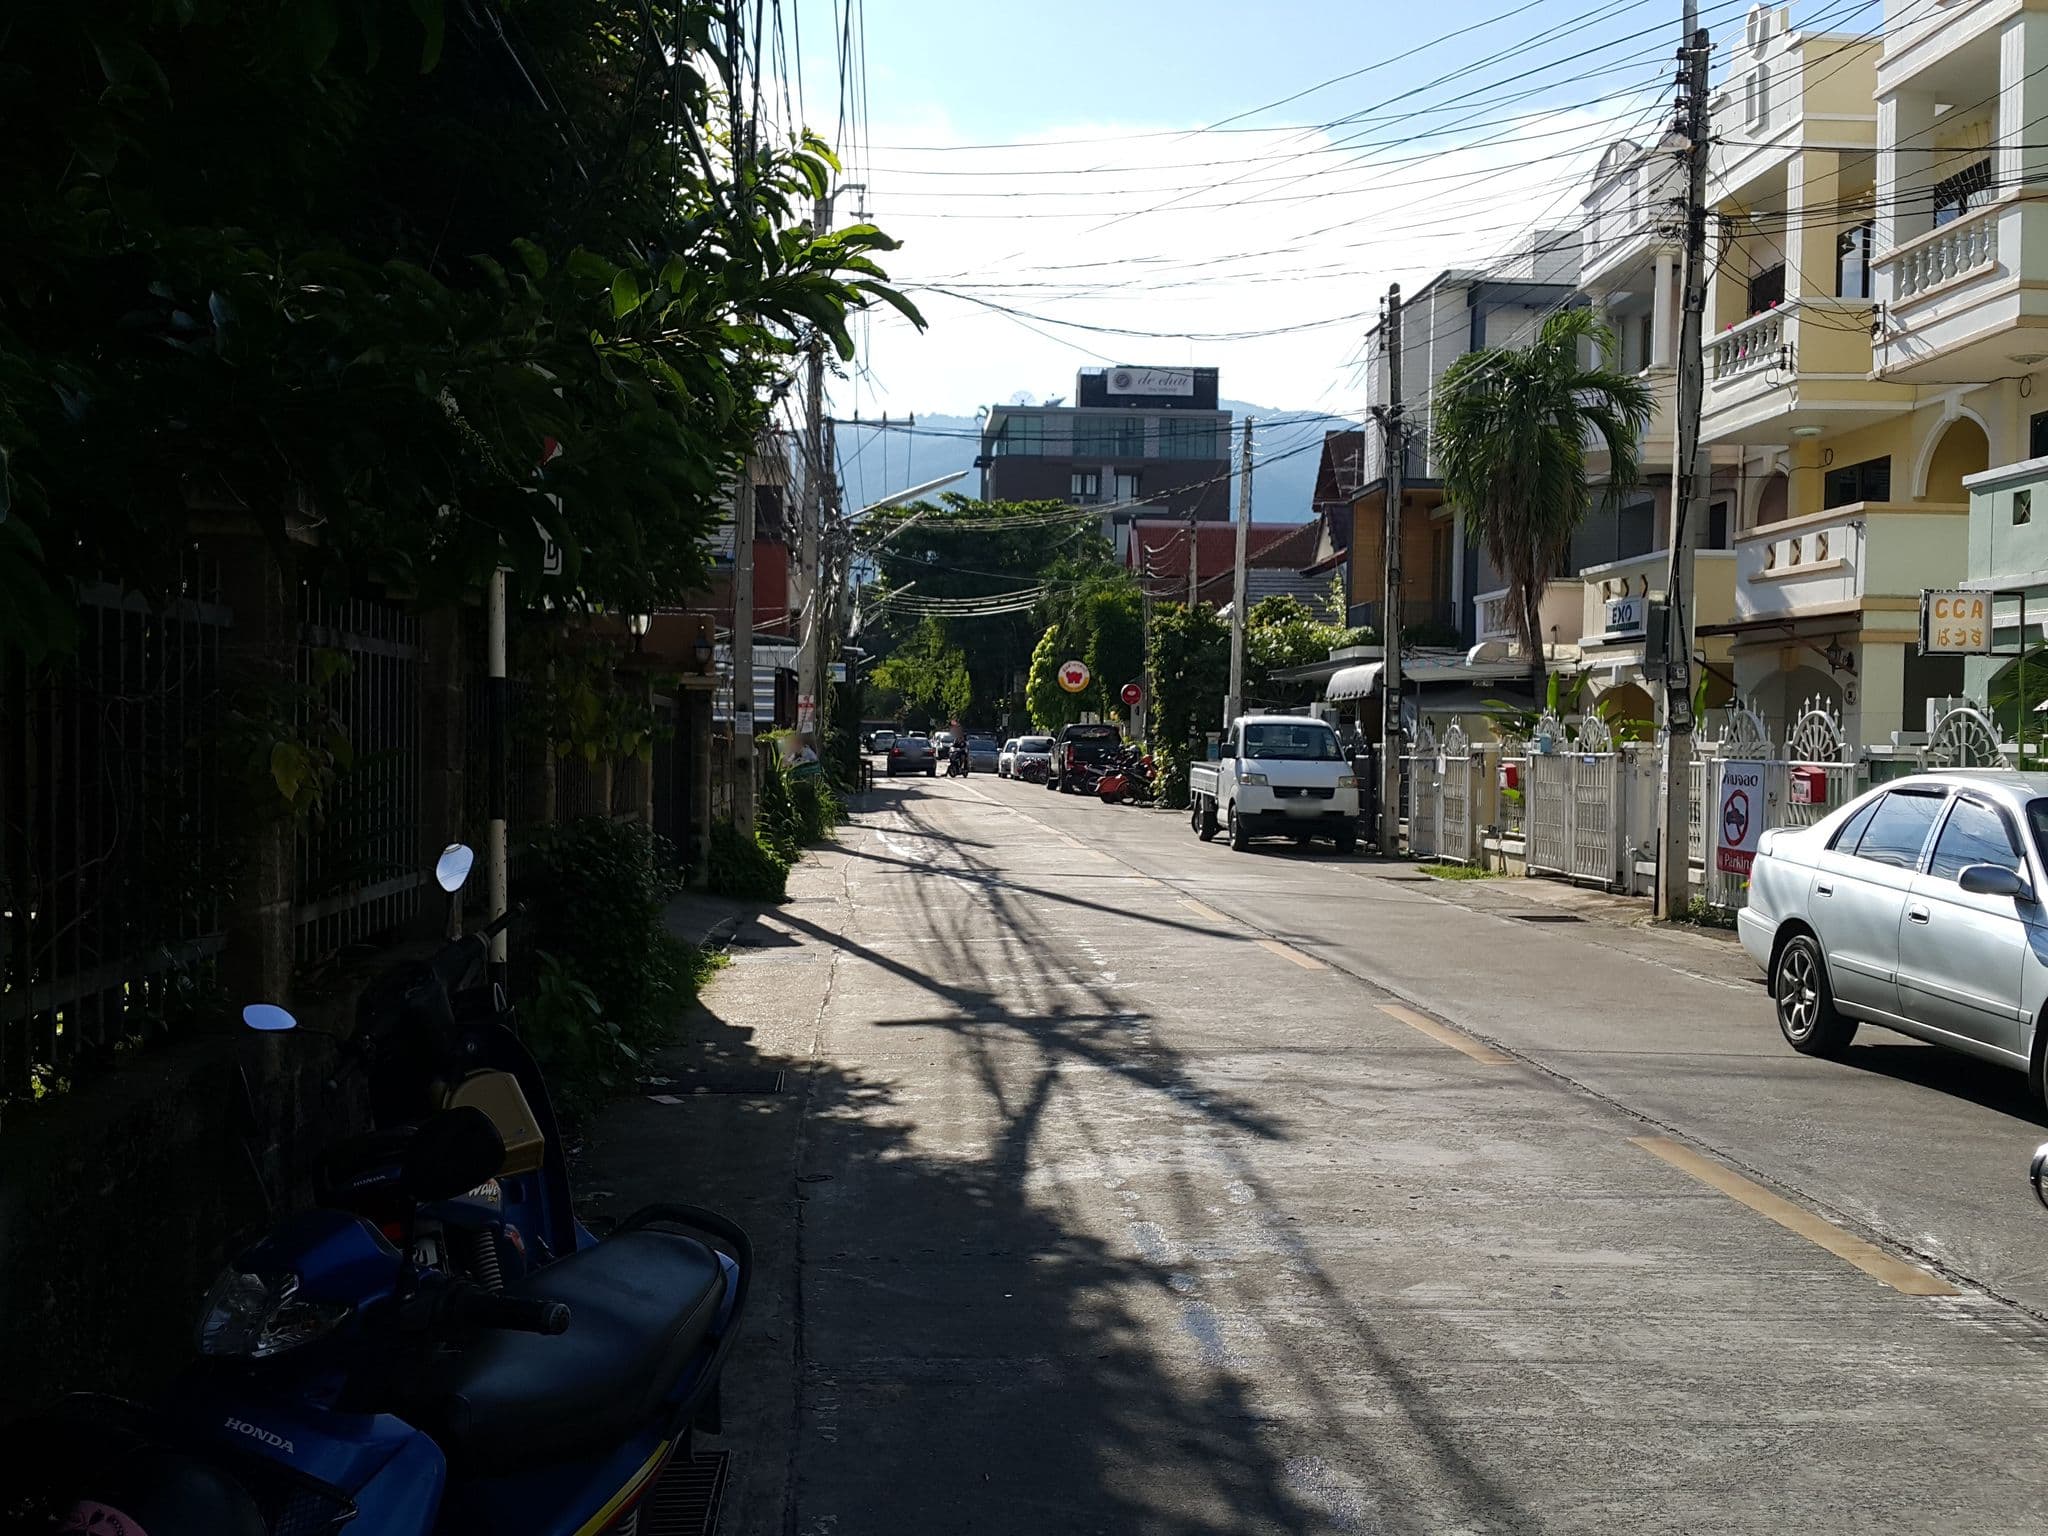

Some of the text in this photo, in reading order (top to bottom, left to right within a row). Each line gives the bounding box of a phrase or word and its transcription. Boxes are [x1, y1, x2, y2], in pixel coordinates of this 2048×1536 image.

[1612, 604, 1633, 624] EXO
[1935, 598, 1984, 619] CCA
[224, 1416, 295, 1455] HONDA
